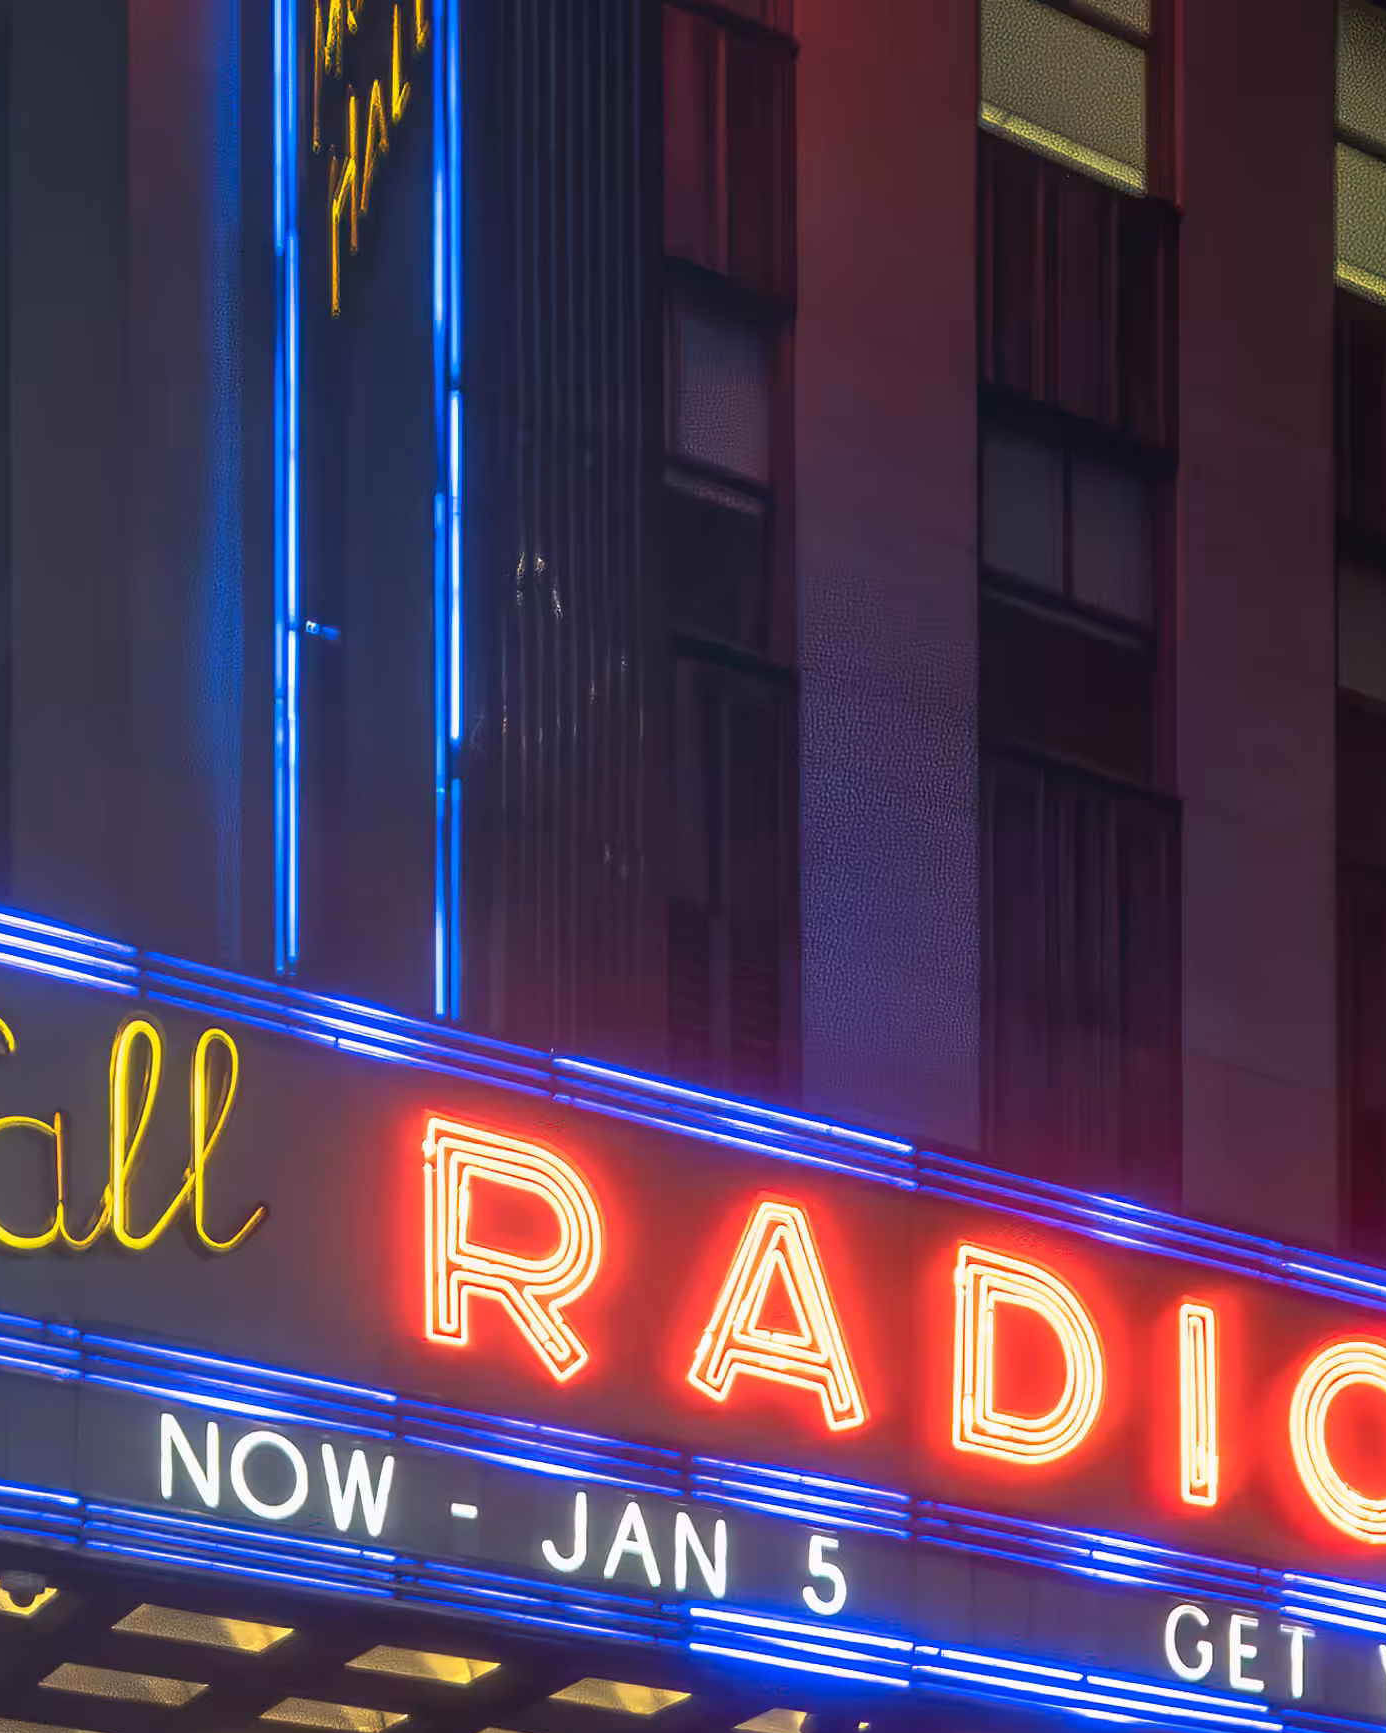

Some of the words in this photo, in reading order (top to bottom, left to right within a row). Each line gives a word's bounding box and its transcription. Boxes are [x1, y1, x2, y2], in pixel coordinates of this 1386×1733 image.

[159, 1412, 396, 1538] NOW
[542, 1490, 728, 1599] JAN
[802, 1533, 849, 1616] 5
[1163, 1602, 1316, 1699] GET
